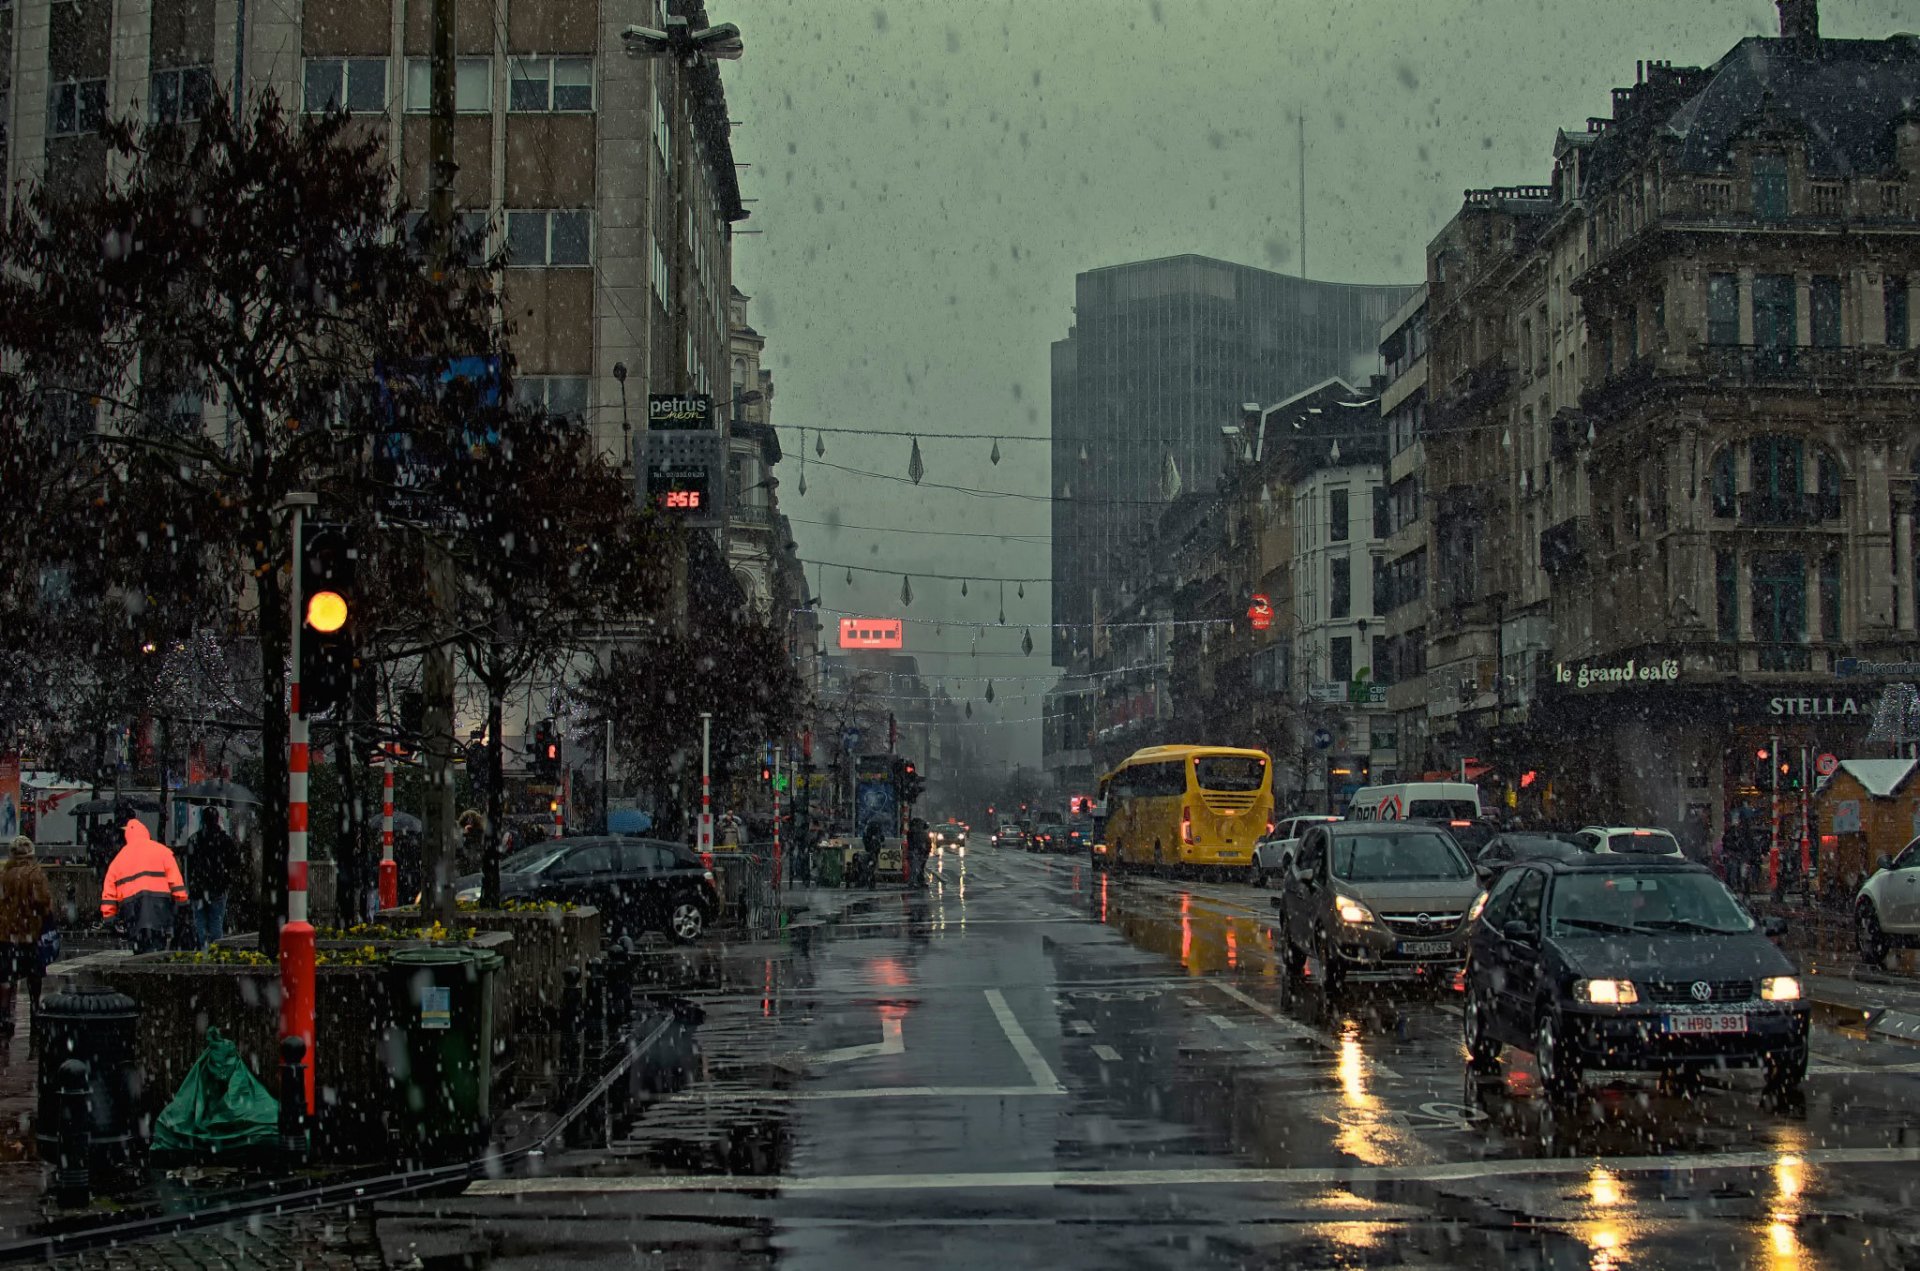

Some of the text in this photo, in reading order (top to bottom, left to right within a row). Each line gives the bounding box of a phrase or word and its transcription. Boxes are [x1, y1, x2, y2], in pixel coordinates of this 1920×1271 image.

[650, 397, 707, 417] petrus
[654, 410, 705, 419] neon
[1556, 659, 1679, 688] le grand café
[1770, 697, 1859, 715] STELLA
[1671, 1015, 1745, 1031] 1-HBG-991
